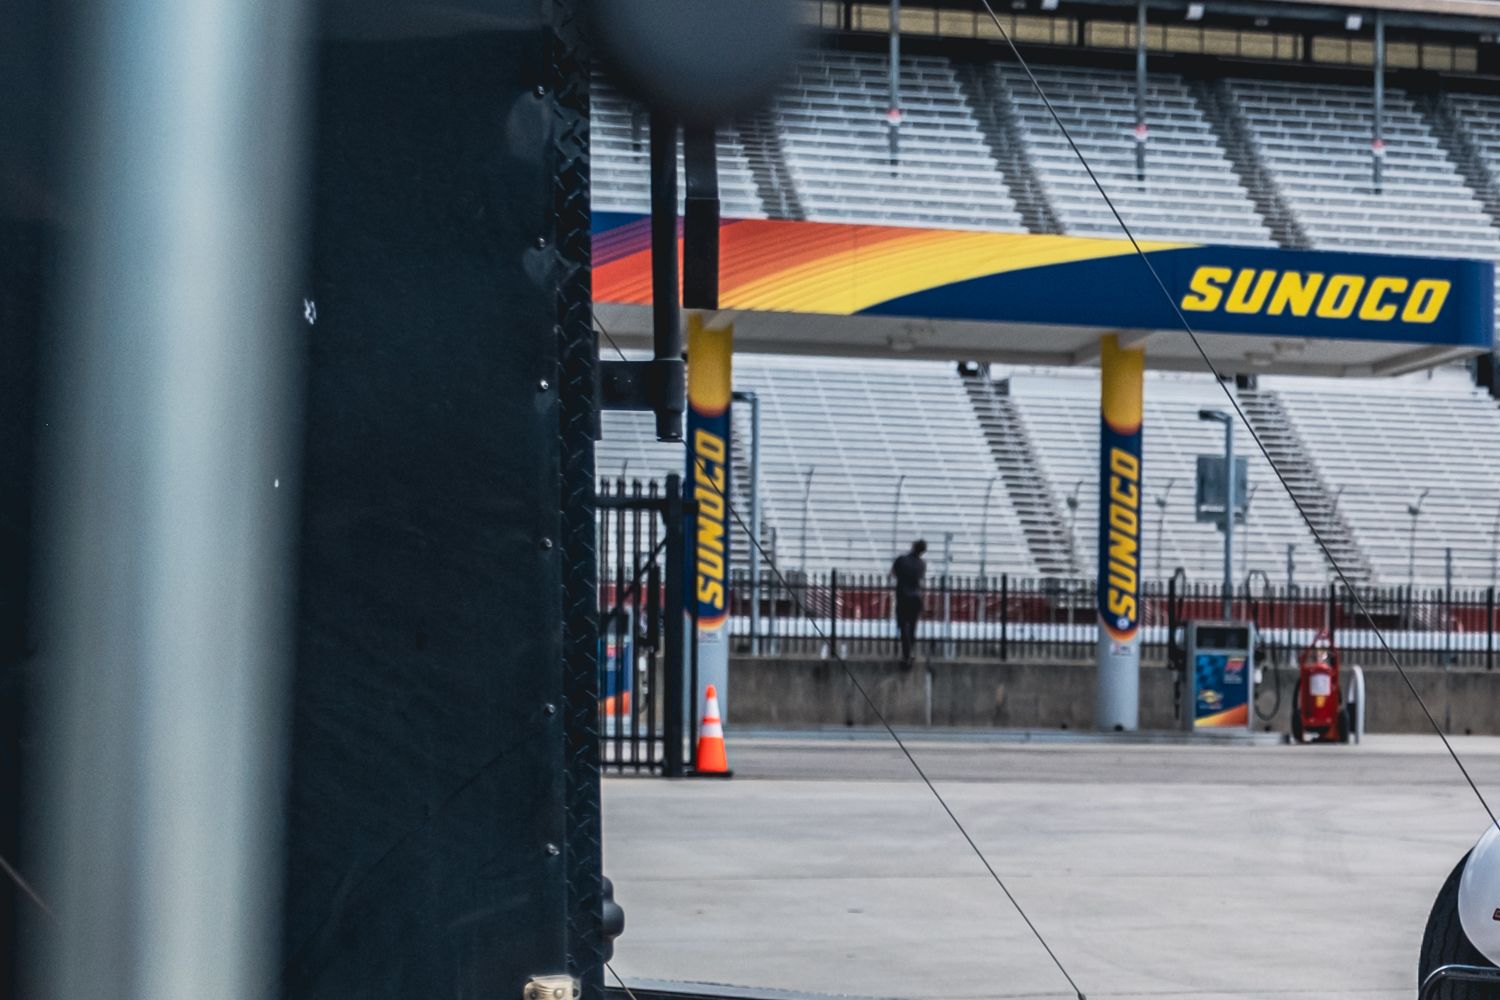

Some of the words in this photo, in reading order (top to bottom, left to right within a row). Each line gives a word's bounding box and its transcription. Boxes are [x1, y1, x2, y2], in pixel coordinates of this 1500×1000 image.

[1180, 266, 1451, 324] SUNOCO
[694, 429, 726, 610] SUNOCO
[1108, 447, 1140, 622] SUNOCO
